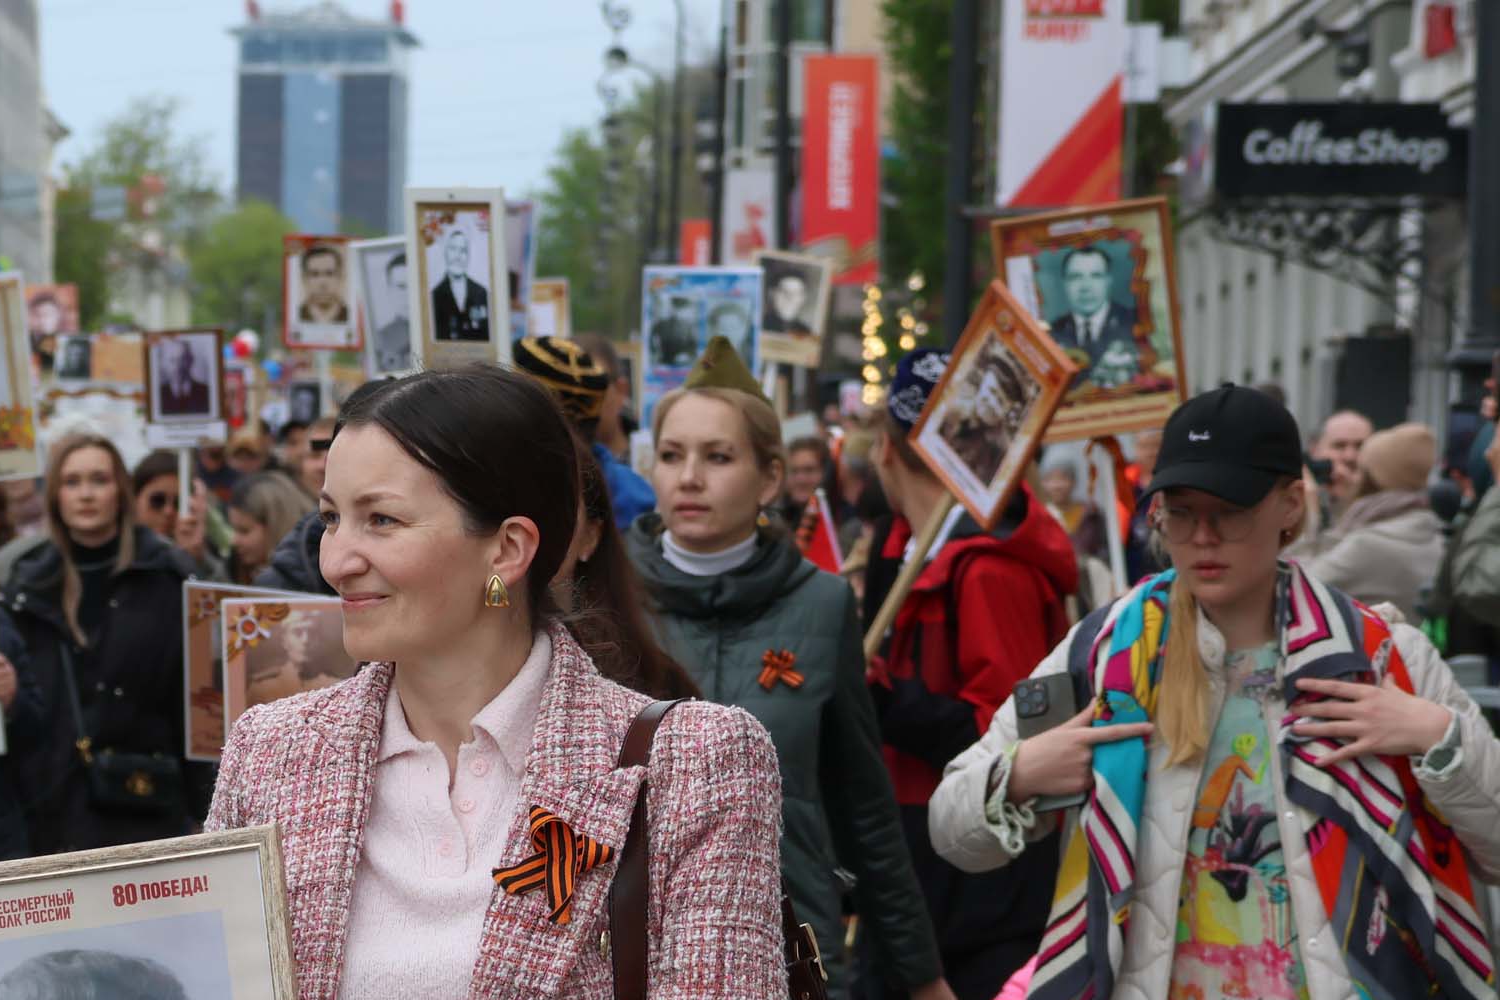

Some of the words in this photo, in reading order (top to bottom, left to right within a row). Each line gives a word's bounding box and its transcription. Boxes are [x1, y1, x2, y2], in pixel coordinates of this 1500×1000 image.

[1243, 119, 1449, 173] CoffeeShop
[112, 883, 138, 907] 80
[140, 875, 209, 900] ПОБЕДА!
[25, 906, 71, 925] РОССИИ
